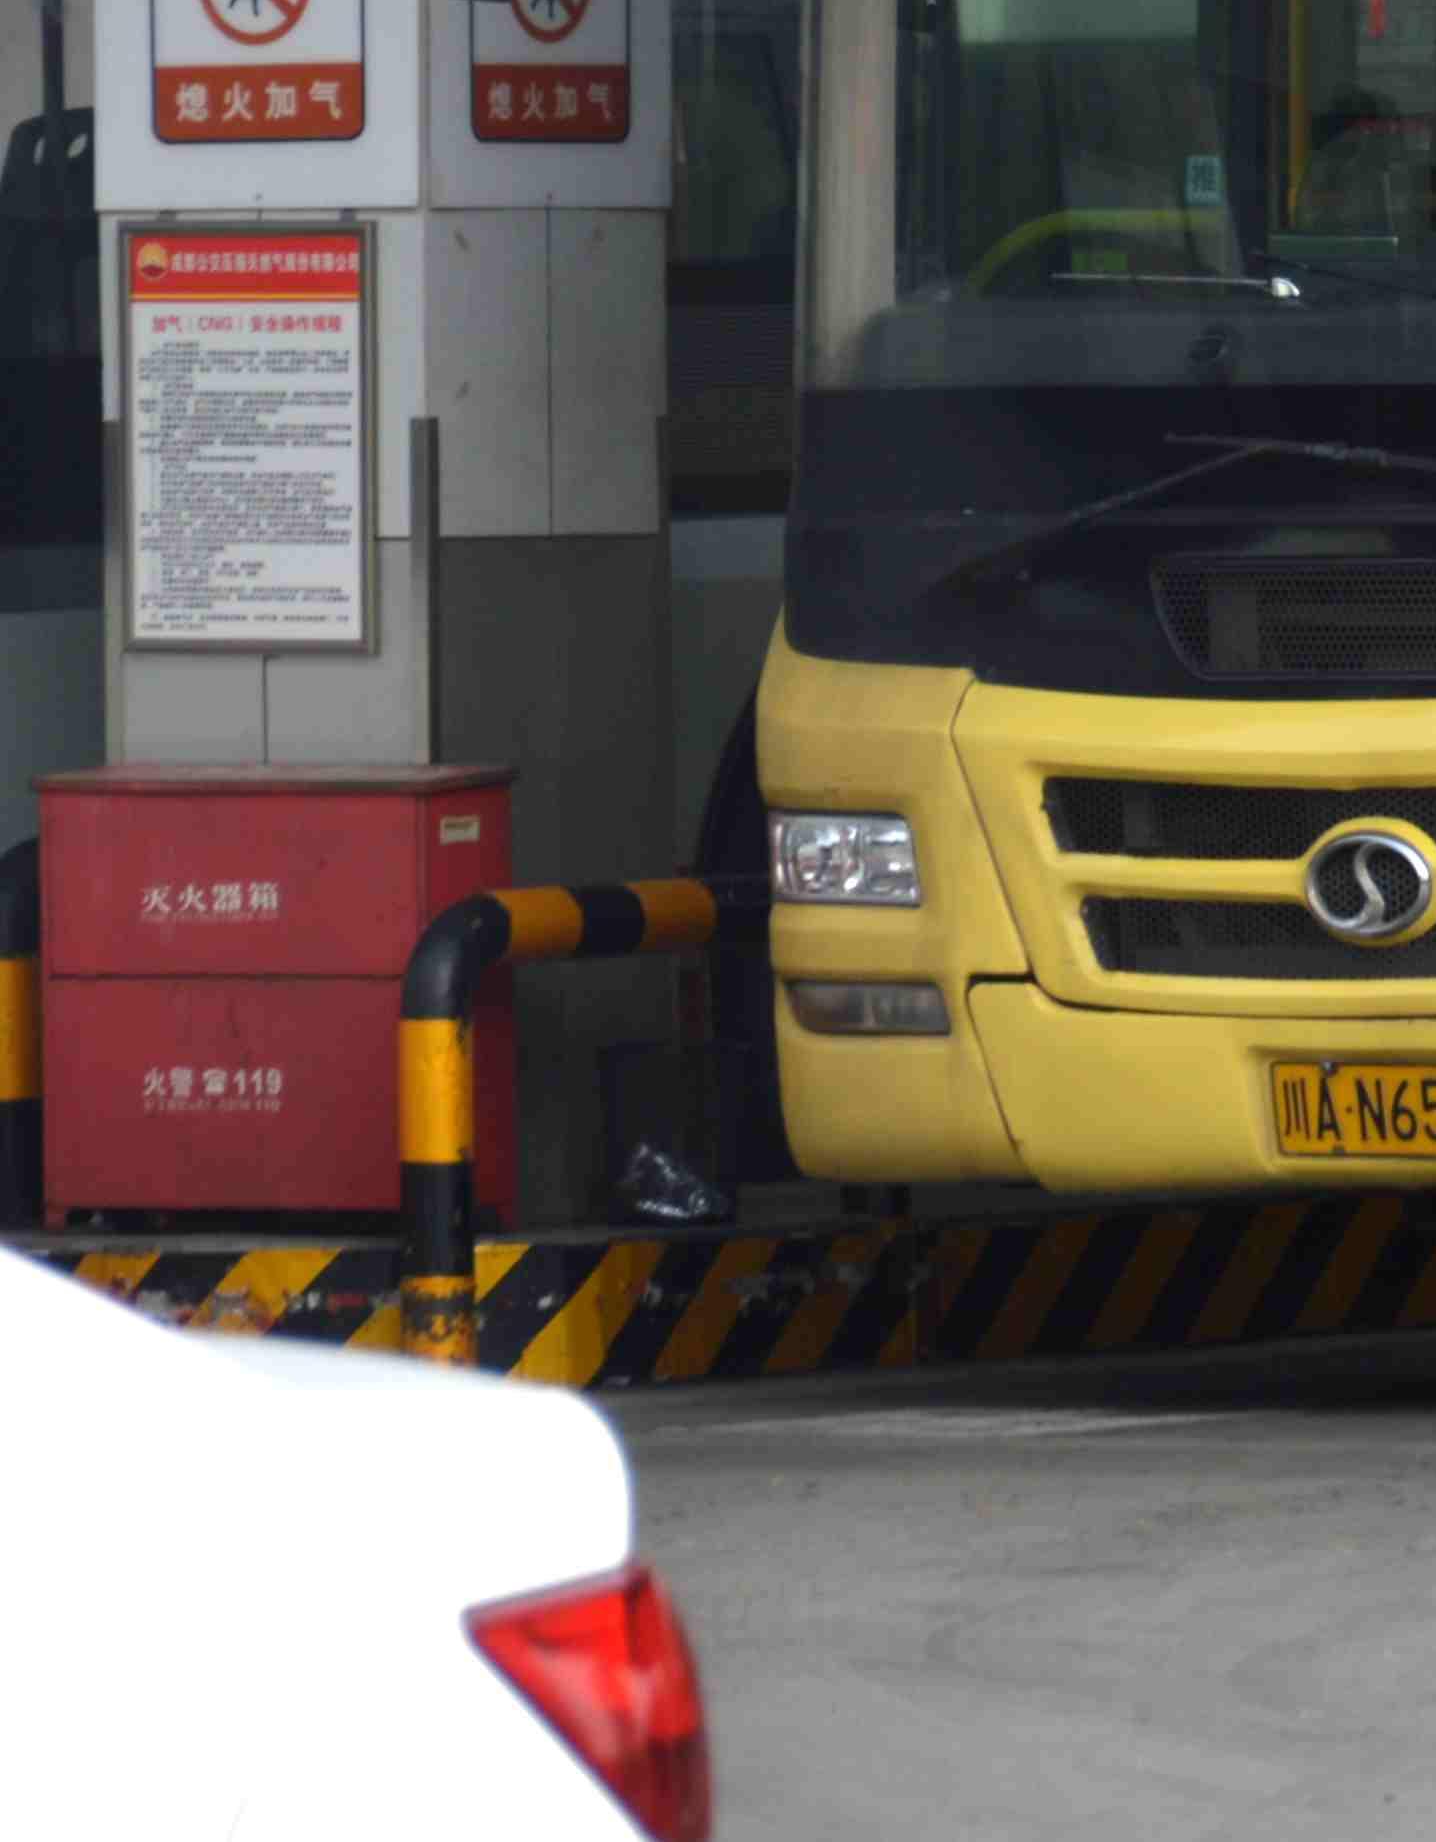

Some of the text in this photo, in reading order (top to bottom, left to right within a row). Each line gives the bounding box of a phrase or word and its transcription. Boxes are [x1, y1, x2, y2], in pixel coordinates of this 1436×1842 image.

[175, 78, 344, 124] 熄火加气
[487, 81, 614, 123] 熄火加气
[140, 880, 281, 913] 灭火器箱
[143, 1066, 284, 1098] 火警 119
